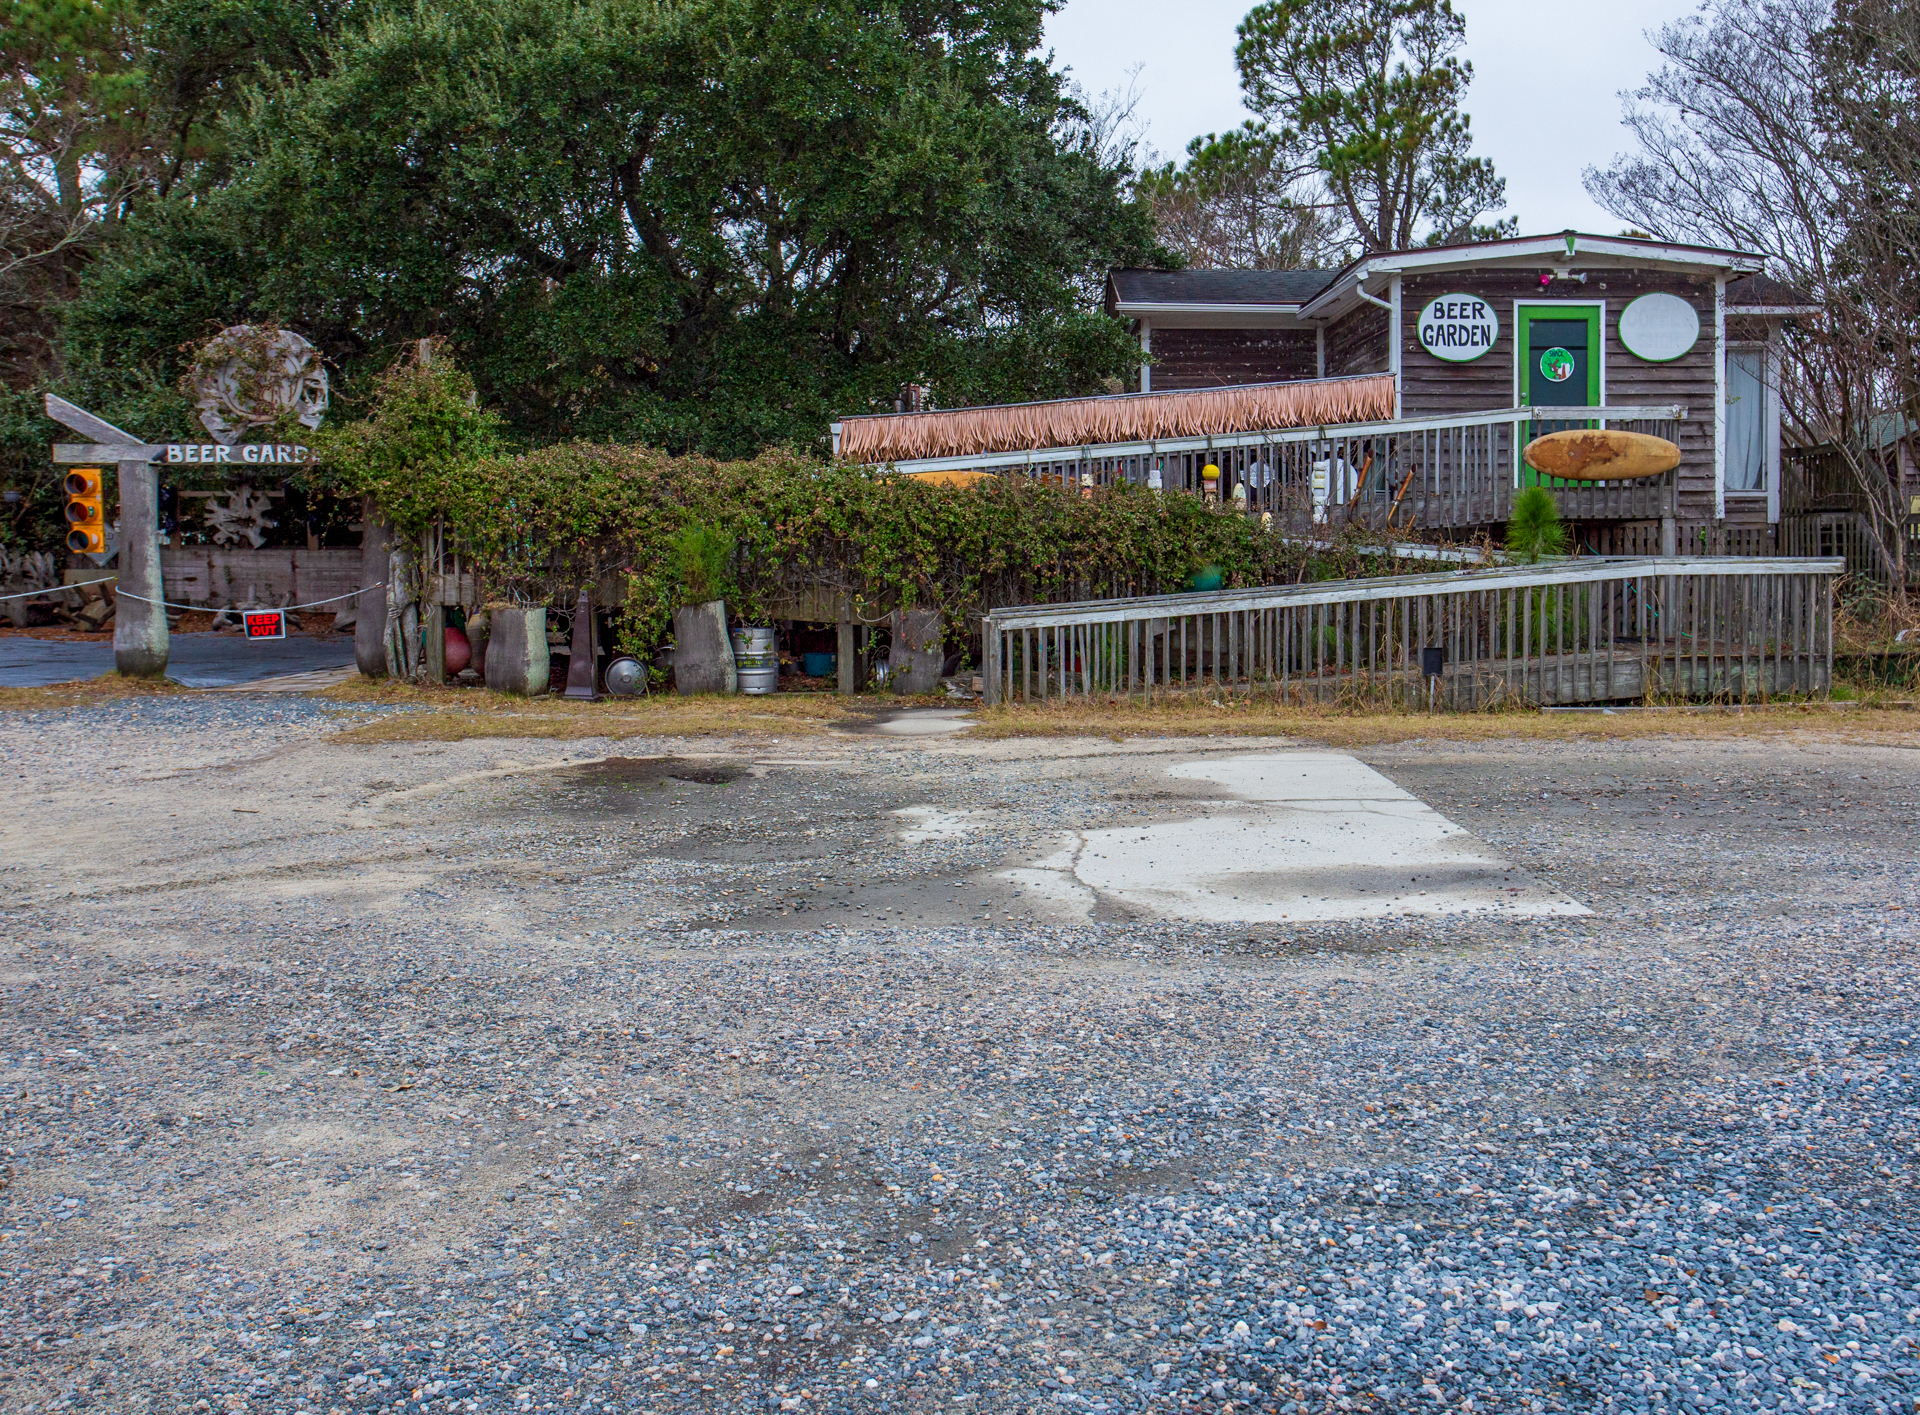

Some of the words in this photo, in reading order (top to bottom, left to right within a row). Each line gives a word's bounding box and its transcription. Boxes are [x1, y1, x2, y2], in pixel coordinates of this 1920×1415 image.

[1433, 302, 1486, 320] BEER
[1422, 324, 1491, 347] GARDEN
[167, 444, 231, 463] BEER
[246, 613, 279, 626] KEEP
[251, 625, 277, 636] OUT
